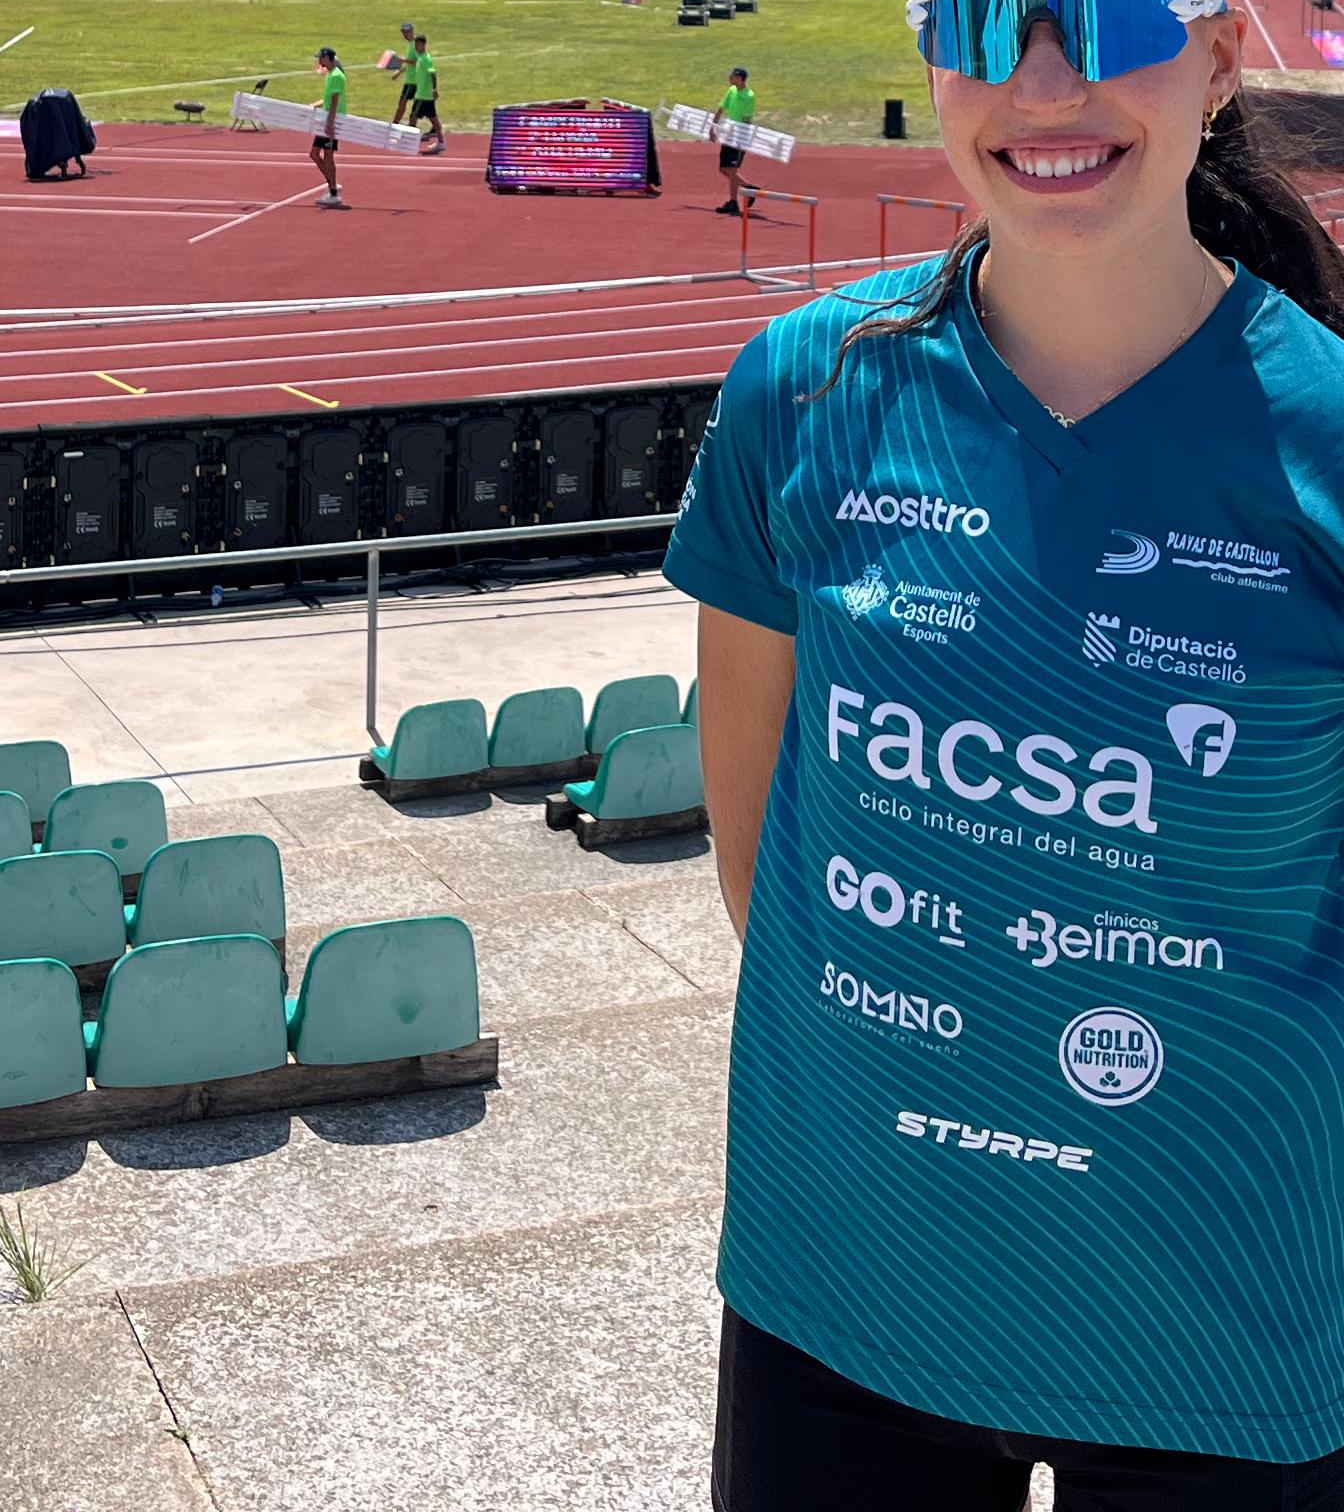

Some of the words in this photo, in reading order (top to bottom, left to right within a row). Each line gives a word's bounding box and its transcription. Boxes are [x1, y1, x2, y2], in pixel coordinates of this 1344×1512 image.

[835, 488, 990, 537] Mosttro
[1166, 531, 1206, 555] PLAYAS
[1208, 538, 1223, 558] DE
[1224, 541, 1280, 567] CASTELLON
[894, 580, 963, 604] Ajuntament
[964, 591, 981, 607] de
[1210, 571, 1236, 585] club
[889, 595, 976, 633] Castelló
[902, 623, 948, 645] Esports
[1128, 625, 1237, 661] Diputació
[1125, 649, 1153, 669] de
[1157, 653, 1247, 684] Castelló
[859, 790, 912, 821] ciclo
[922, 806, 1022, 848] integral
[1035, 831, 1076, 858] del
[1088, 843, 1156, 872] agua
[820, 960, 963, 1039] SOMNO
[1080, 1027, 1143, 1052] GOLD
[1074, 1048, 1149, 1069] NUTRITION
[896, 1111, 1094, 1173] STYRPE
